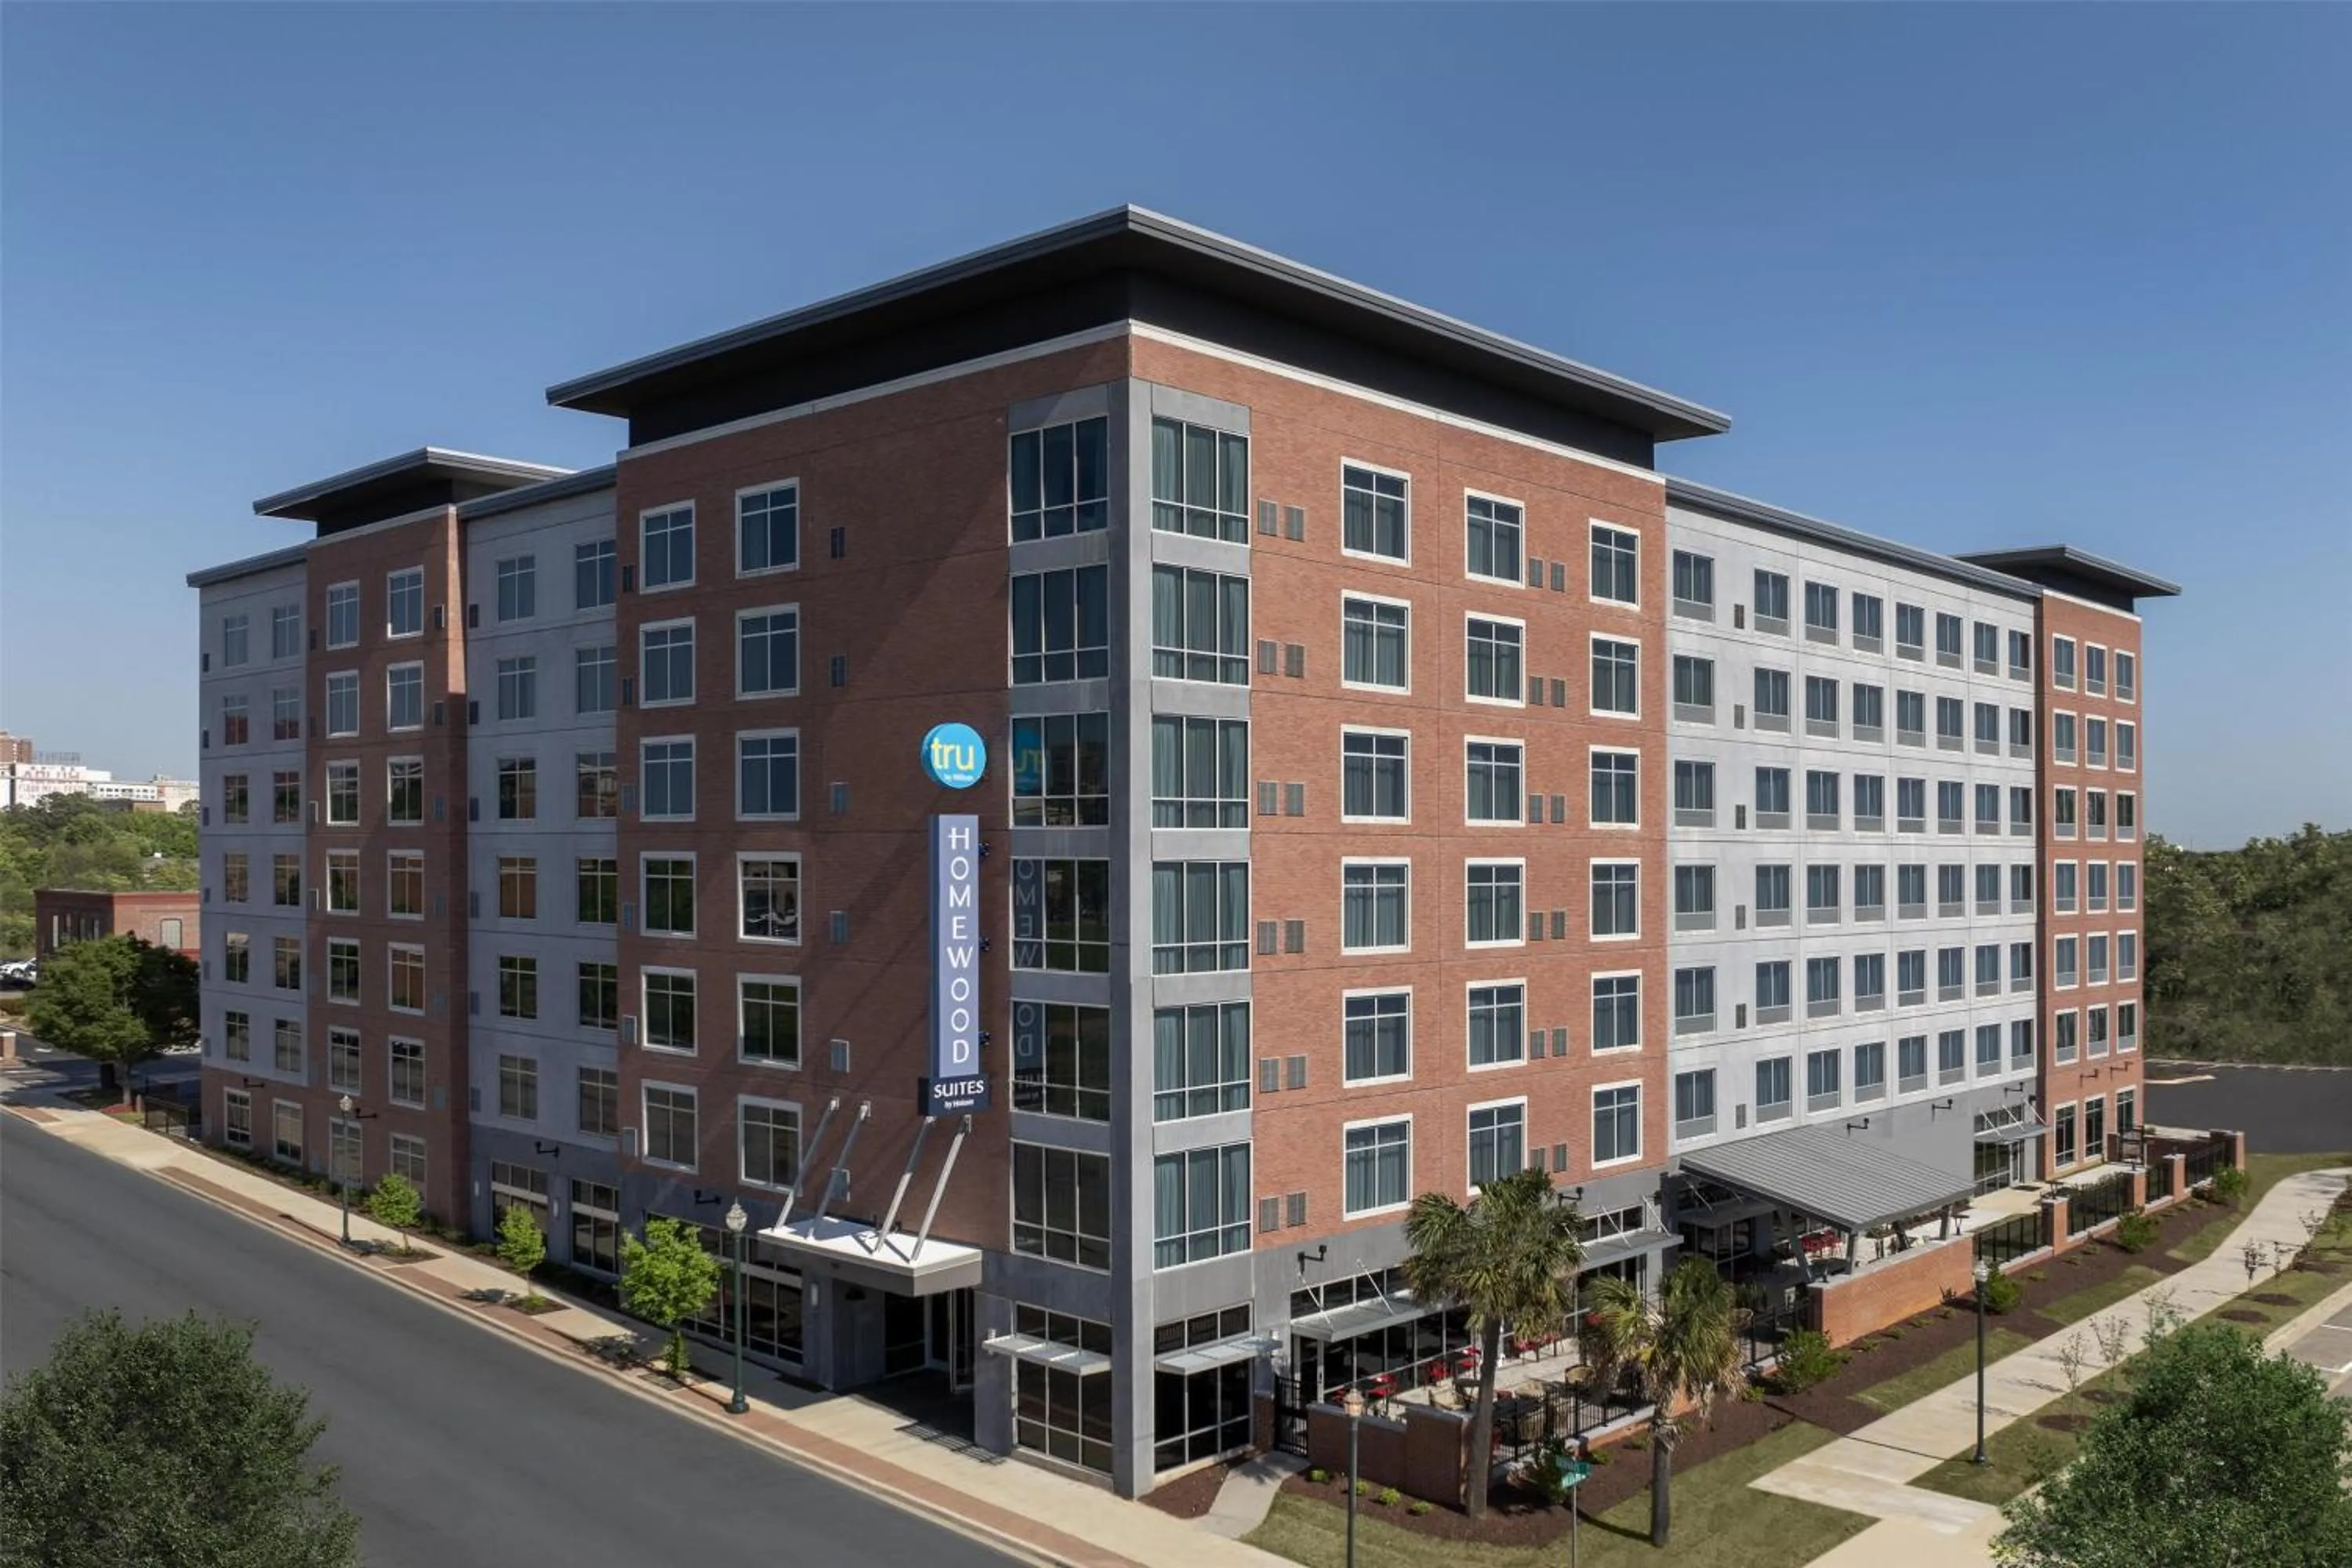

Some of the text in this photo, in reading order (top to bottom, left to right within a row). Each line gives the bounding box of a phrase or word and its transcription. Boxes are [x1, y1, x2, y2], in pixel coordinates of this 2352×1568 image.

[931, 737, 975, 771] tru
[947, 827, 973, 1064] HOMEWOOD
[934, 1080, 985, 1098] SUITES
